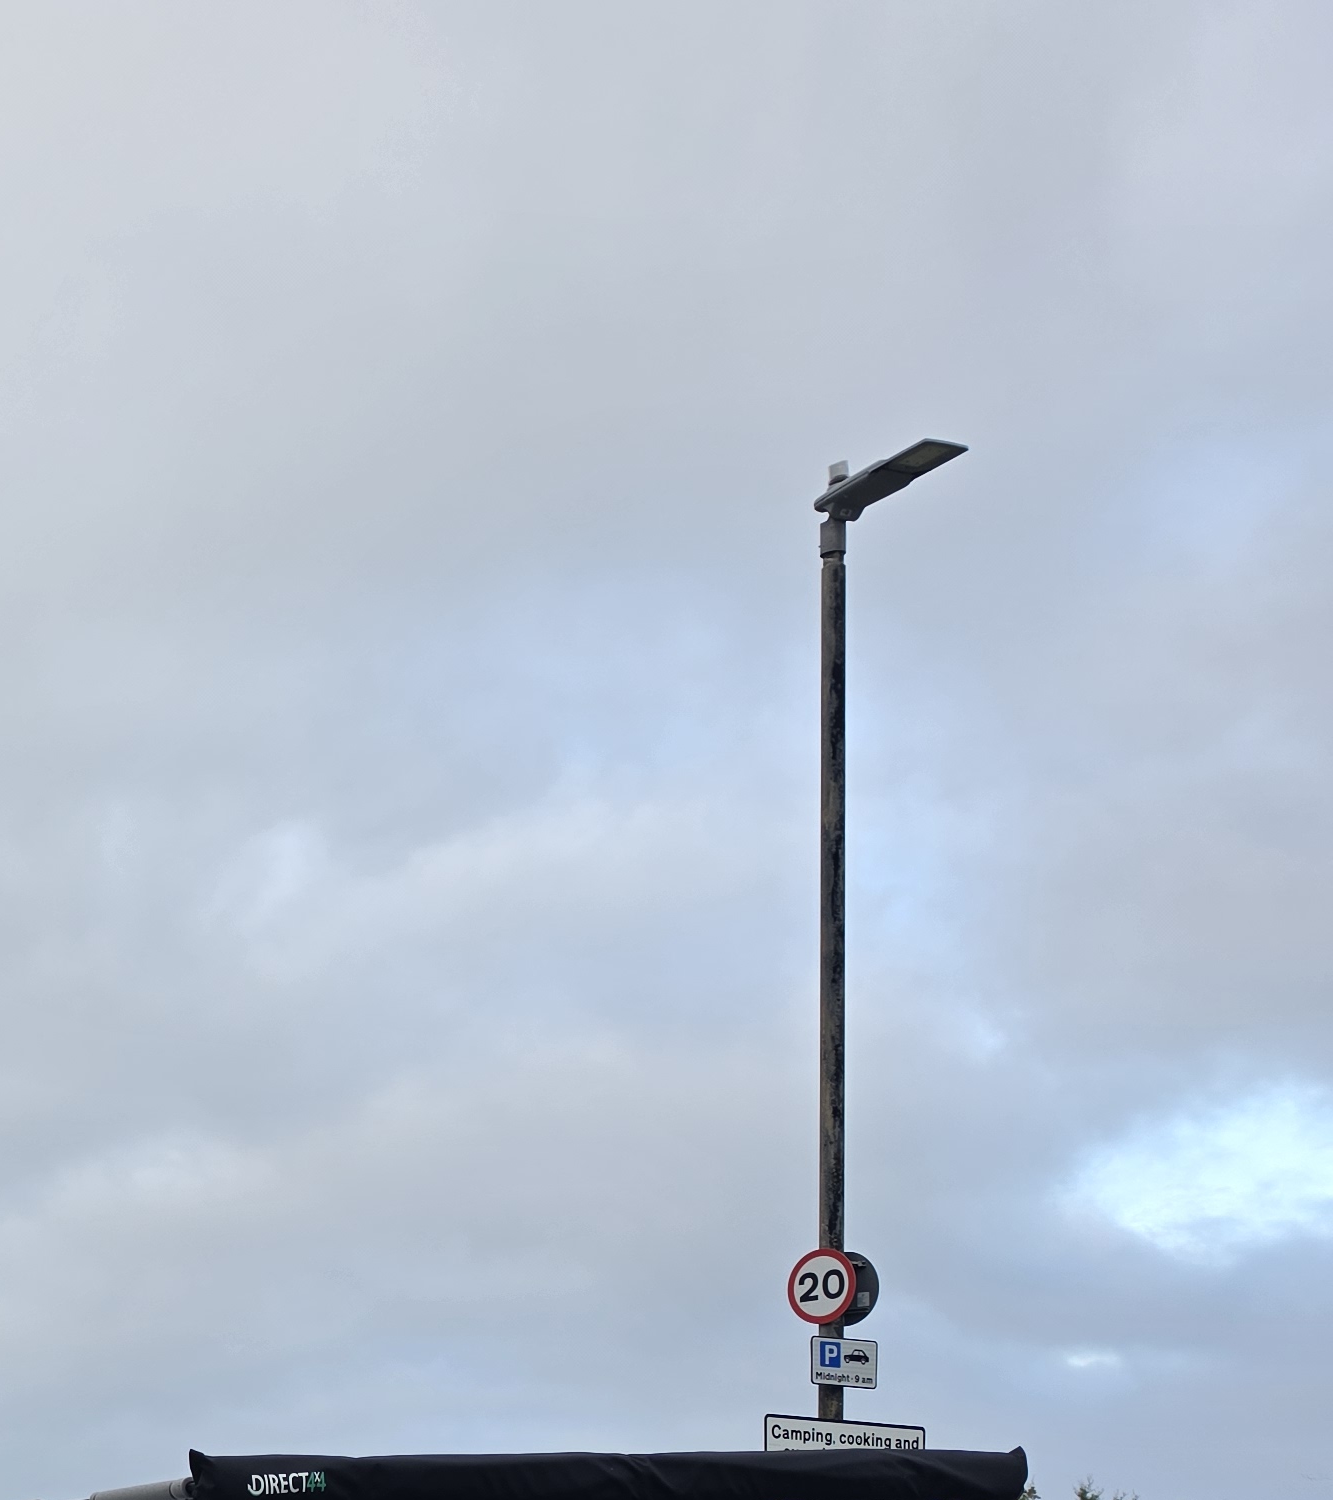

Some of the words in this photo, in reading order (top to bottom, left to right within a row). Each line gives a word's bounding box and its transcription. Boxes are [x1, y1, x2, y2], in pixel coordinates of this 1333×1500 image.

[798, 1269, 845, 1303] 20
[824, 1344, 838, 1365] P
[815, 1371, 850, 1383] Midnight
[854, 1374, 860, 1383] 9
[771, 1424, 836, 1446] Camping,
[839, 1432, 892, 1449] cooking
[895, 1436, 920, 1450] and
